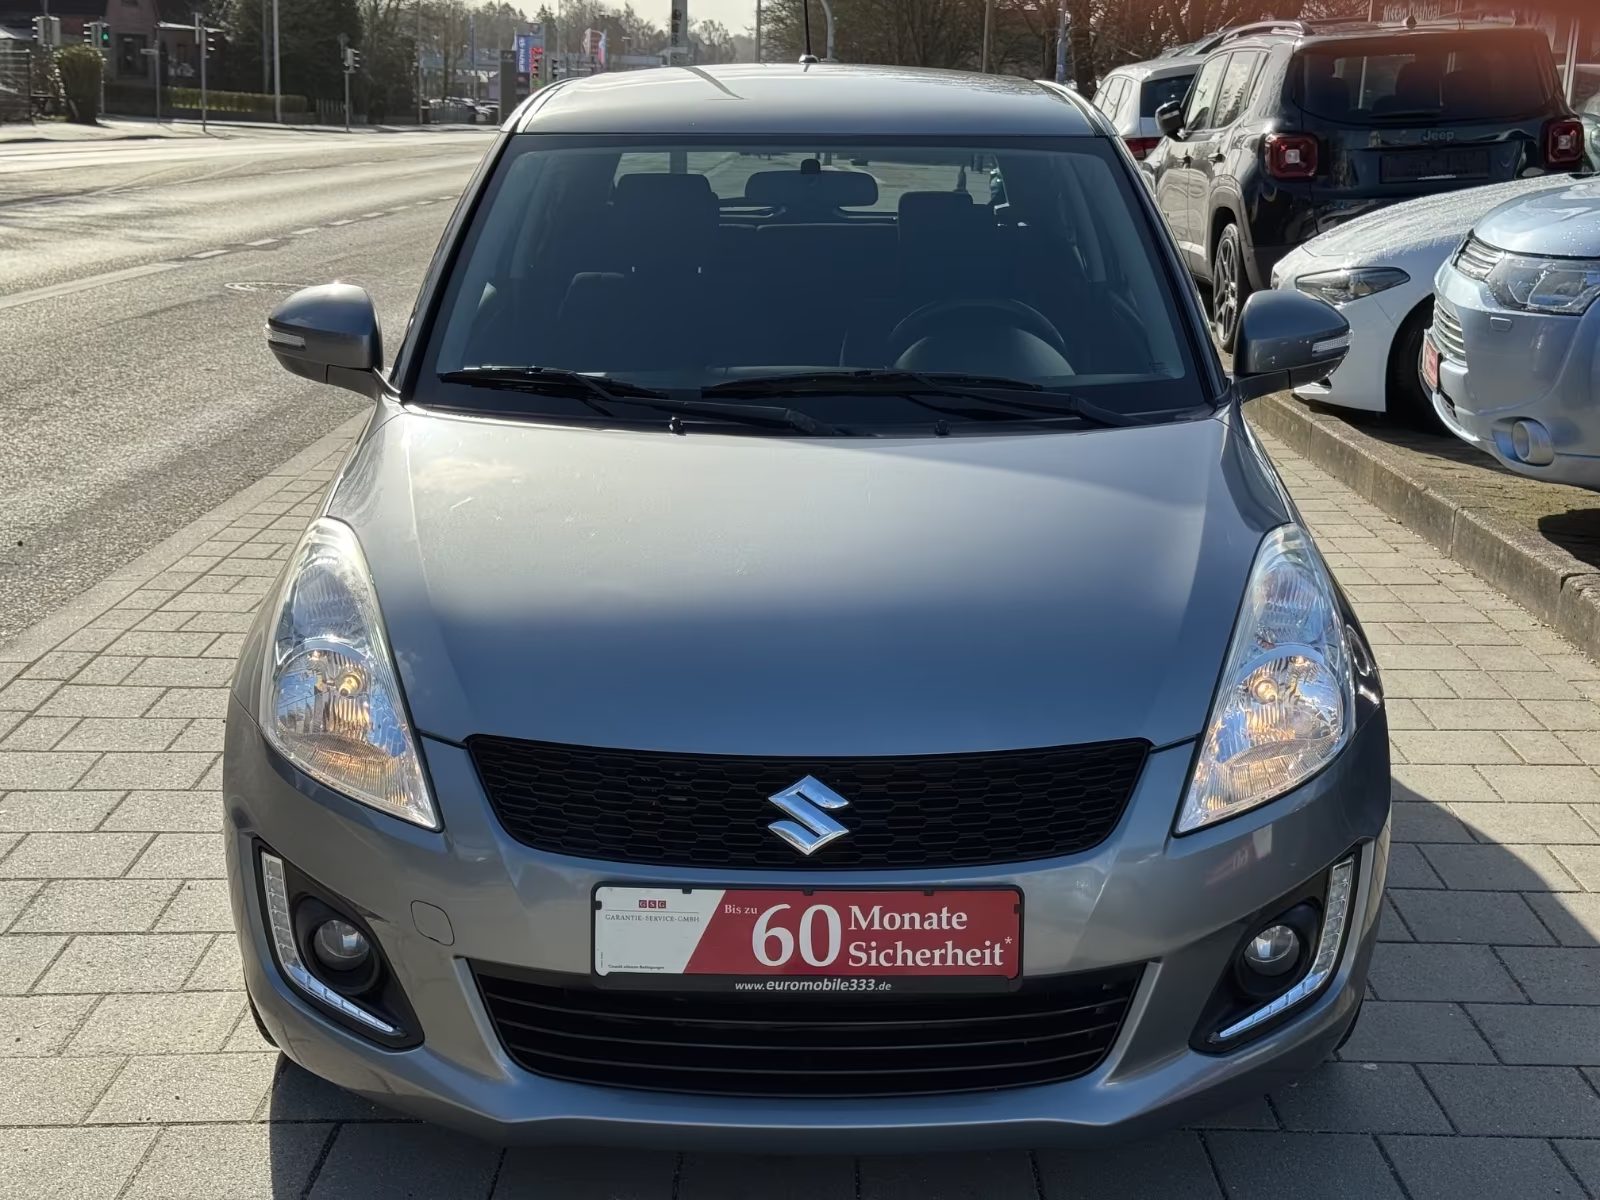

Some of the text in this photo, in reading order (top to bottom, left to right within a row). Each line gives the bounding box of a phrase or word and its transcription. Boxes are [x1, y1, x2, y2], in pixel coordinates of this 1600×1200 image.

[1382, 4, 1407, 21] Nissan
[1423, 129, 1455, 142] Jeep
[638, 899, 667, 909] GSG
[724, 903, 758, 914] Bis zu
[848, 904, 968, 931] Monate
[752, 903, 842, 967] 60
[734, 978, 893, 991] www.euromobile333.de
